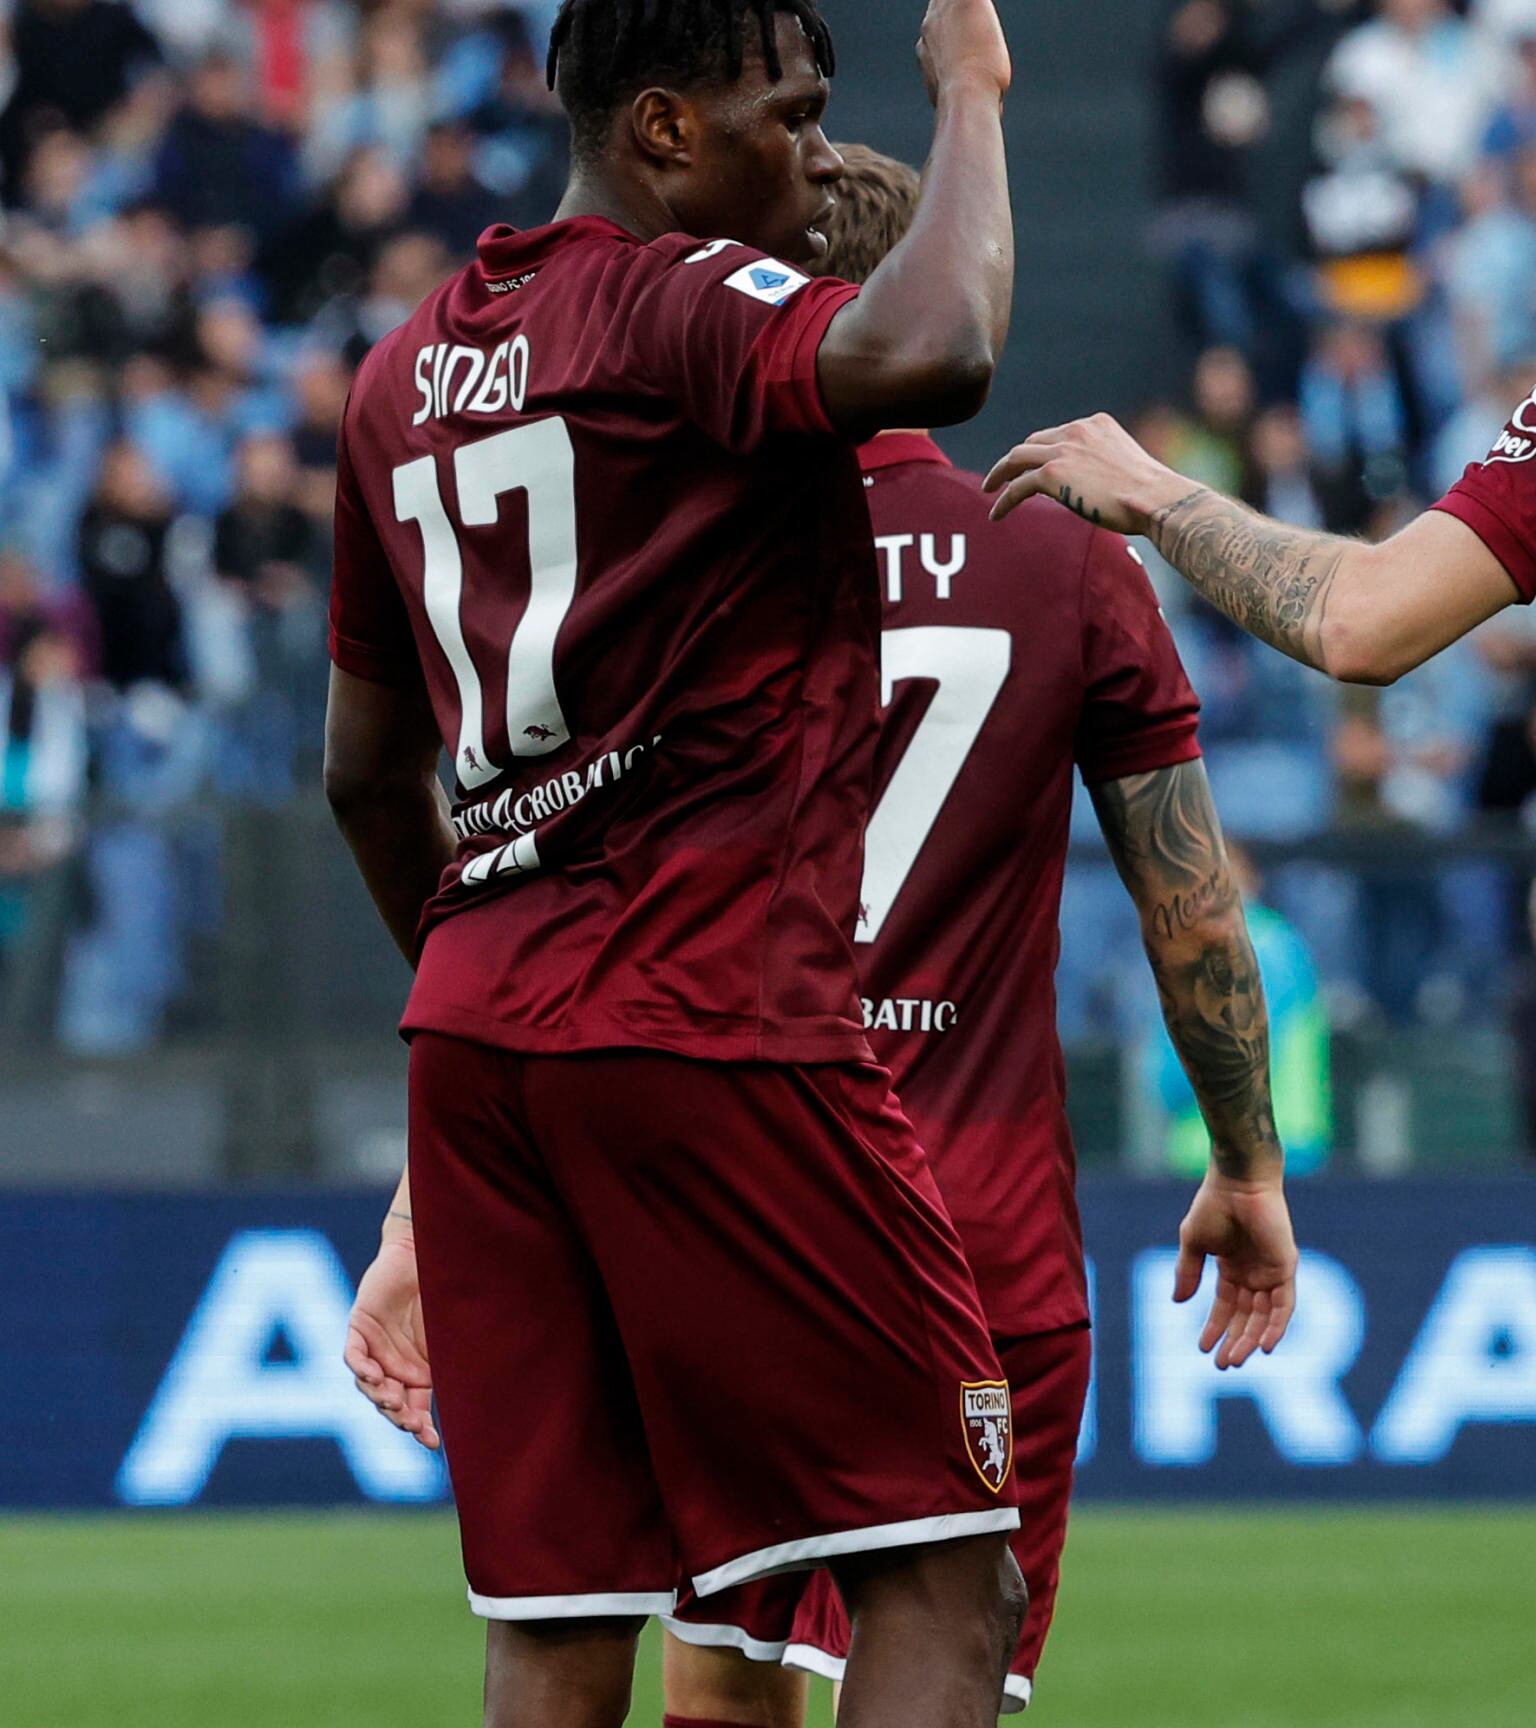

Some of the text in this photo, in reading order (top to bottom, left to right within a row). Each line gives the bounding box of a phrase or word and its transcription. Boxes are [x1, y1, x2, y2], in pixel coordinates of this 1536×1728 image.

[413, 334, 530, 426] SINGO
[392, 415, 578, 791] 17
[854, 626, 1011, 943] 7
[968, 1392, 1005, 1411] TORINO
[997, 1418, 1008, 1434] FC
